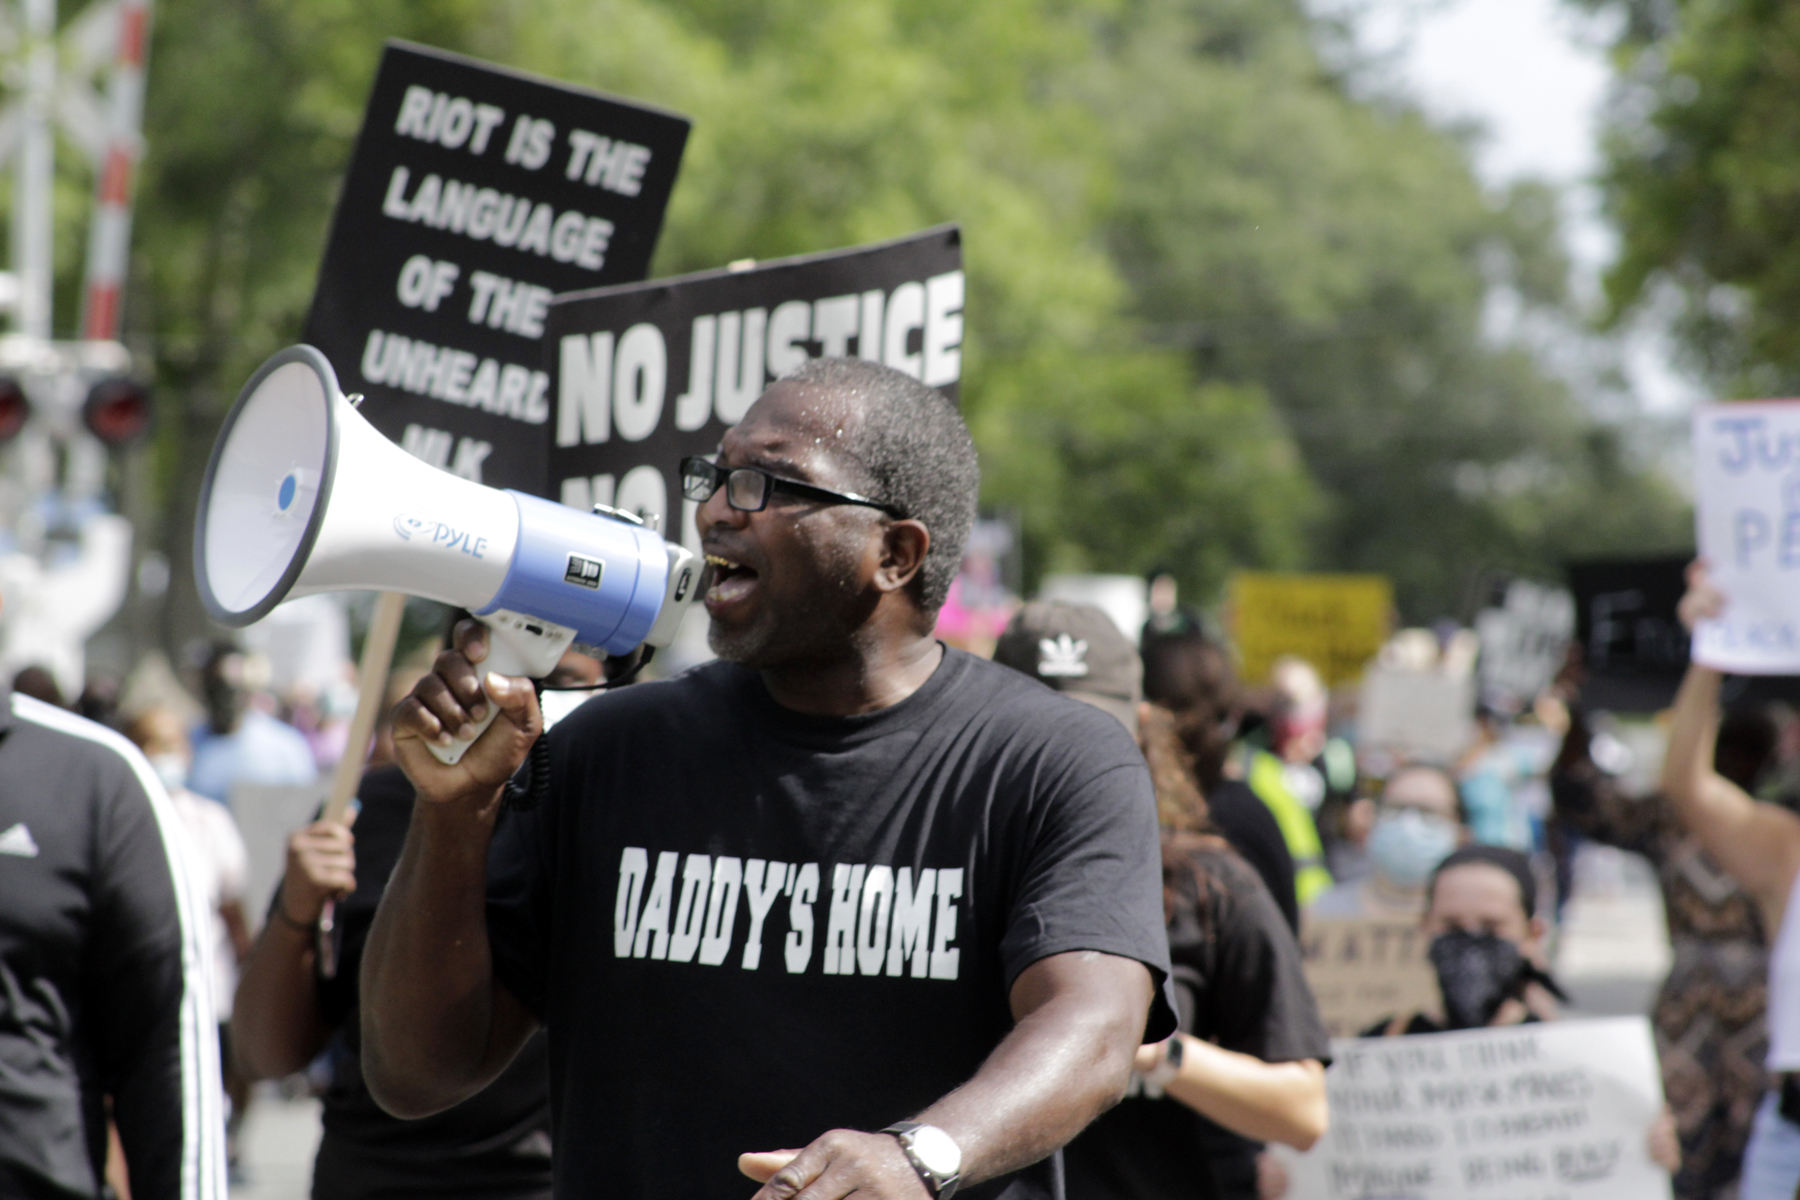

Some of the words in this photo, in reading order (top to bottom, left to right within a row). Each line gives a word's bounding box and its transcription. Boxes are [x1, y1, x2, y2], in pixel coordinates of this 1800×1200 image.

[395, 85, 504, 155] RIOT
[505, 114, 556, 170] IS
[566, 129, 652, 197] THE
[382, 166, 615, 272] LANGUAGE
[397, 254, 460, 312] OF
[467, 270, 552, 340] THE
[556, 322, 667, 447] NO
[675, 270, 965, 432] JUSTICE
[1712, 417, 1800, 474] JU
[433, 523, 488, 559] PYLE
[614, 846, 820, 974] DADDY'S
[823, 862, 964, 981] HOME
